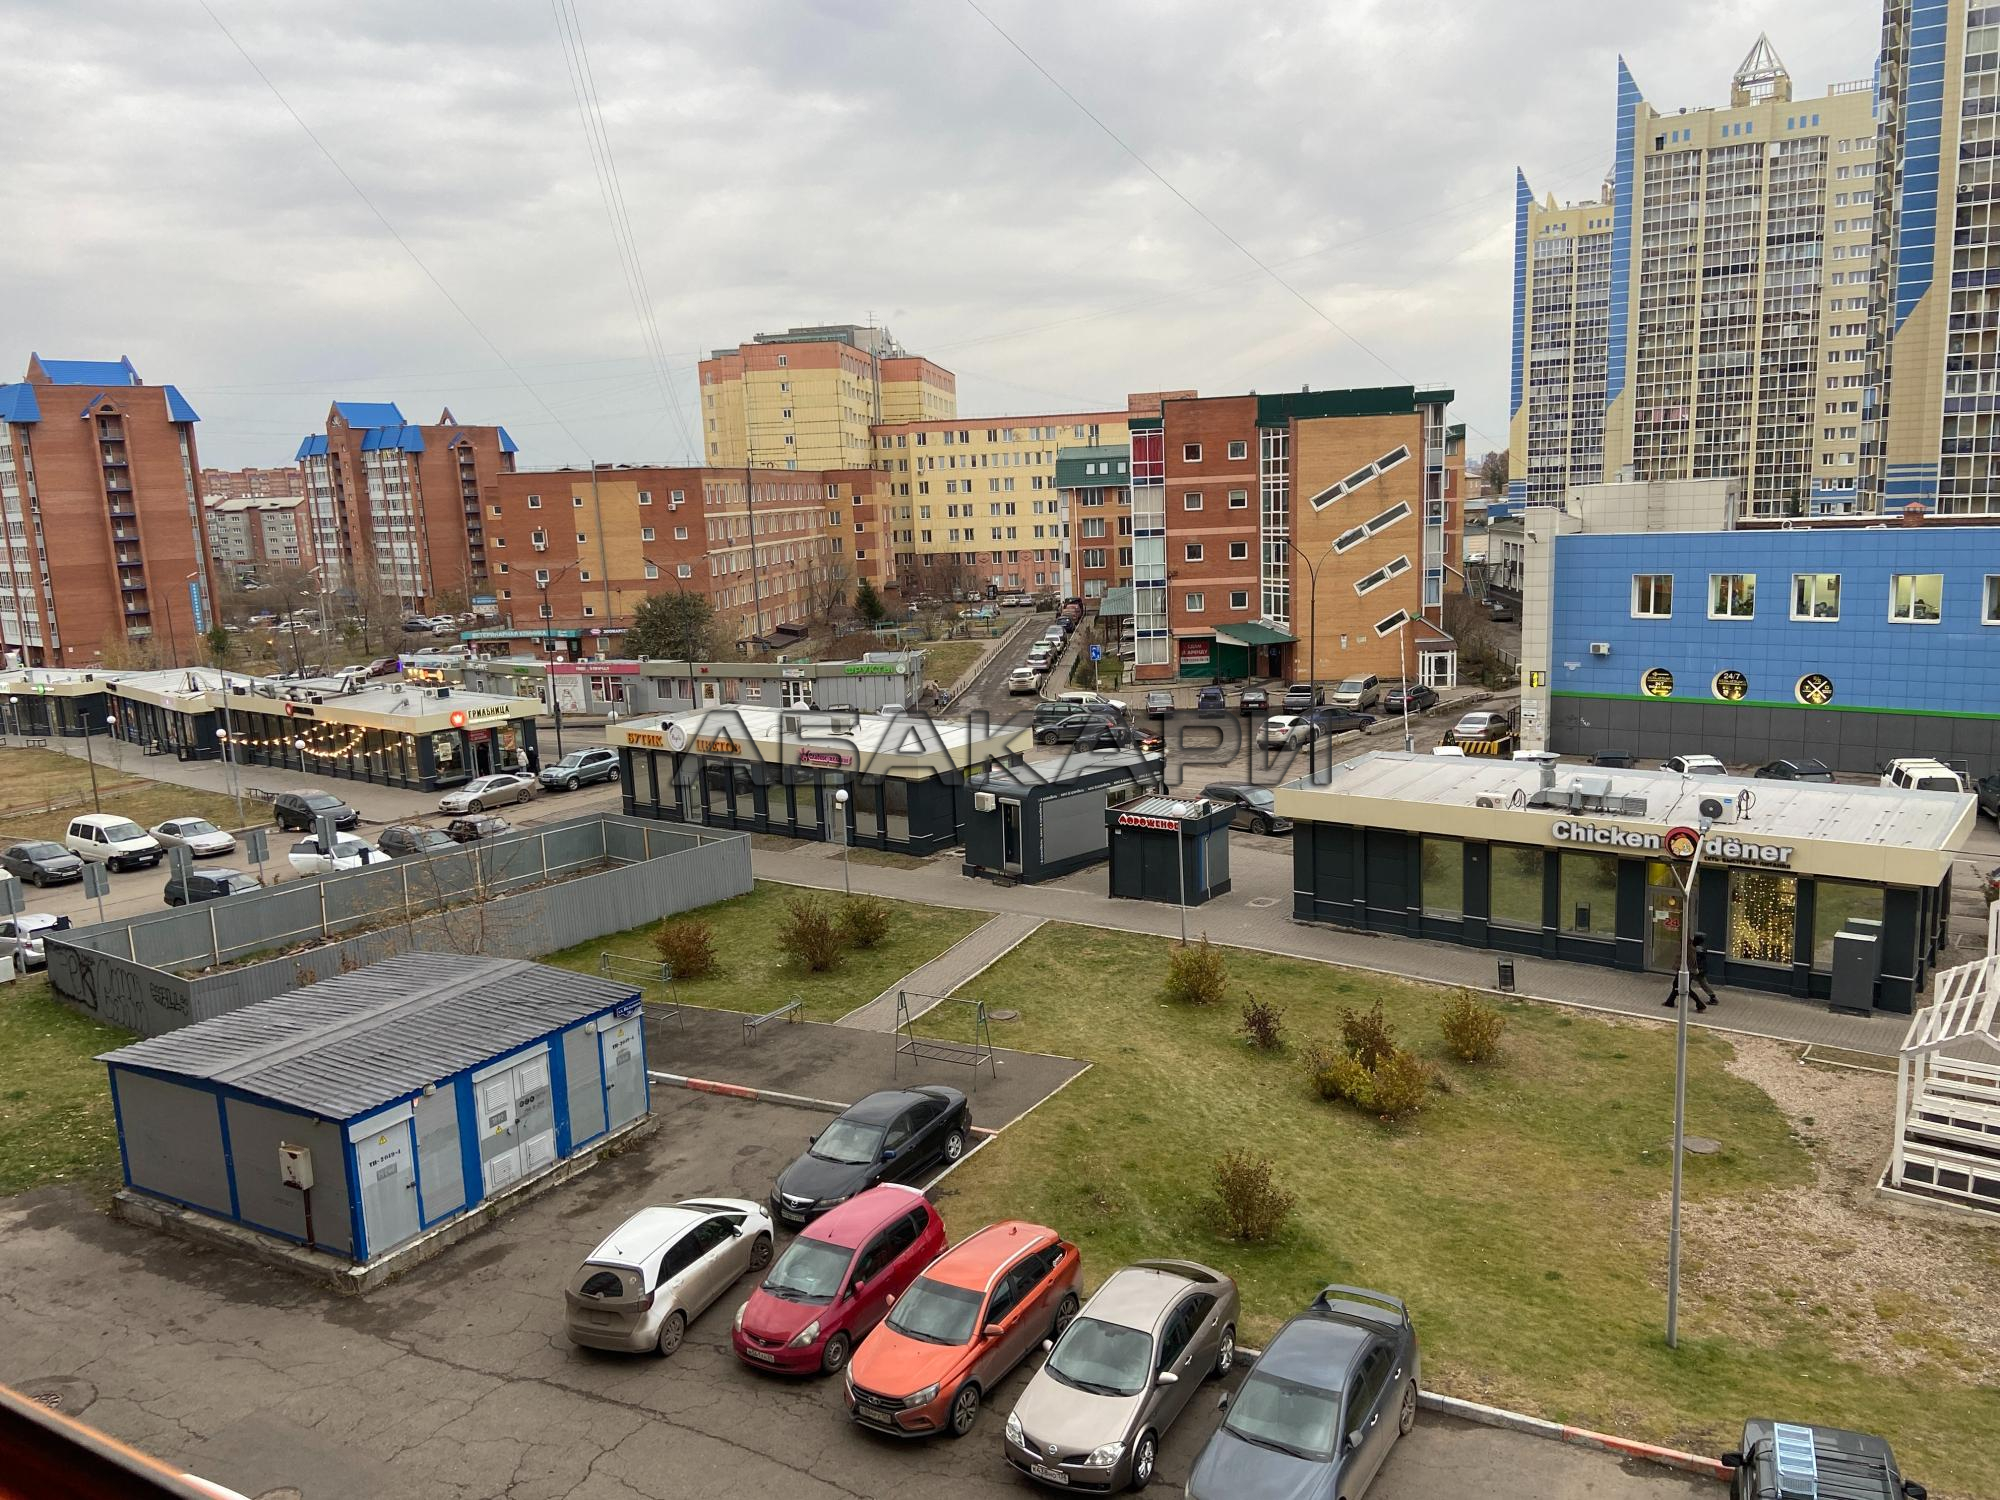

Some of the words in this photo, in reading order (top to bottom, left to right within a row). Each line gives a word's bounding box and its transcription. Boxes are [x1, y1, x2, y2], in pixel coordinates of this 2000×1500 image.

[844, 665, 895, 675] ФРУКТЫ
[467, 704, 510, 719] ГРИЛЬНИЦА
[627, 732, 663, 748] БУТИК
[696, 739, 742, 755] ЦВЕТОВ
[1551, 820, 1661, 849] Chicken
[1705, 836, 1793, 864] dëner
